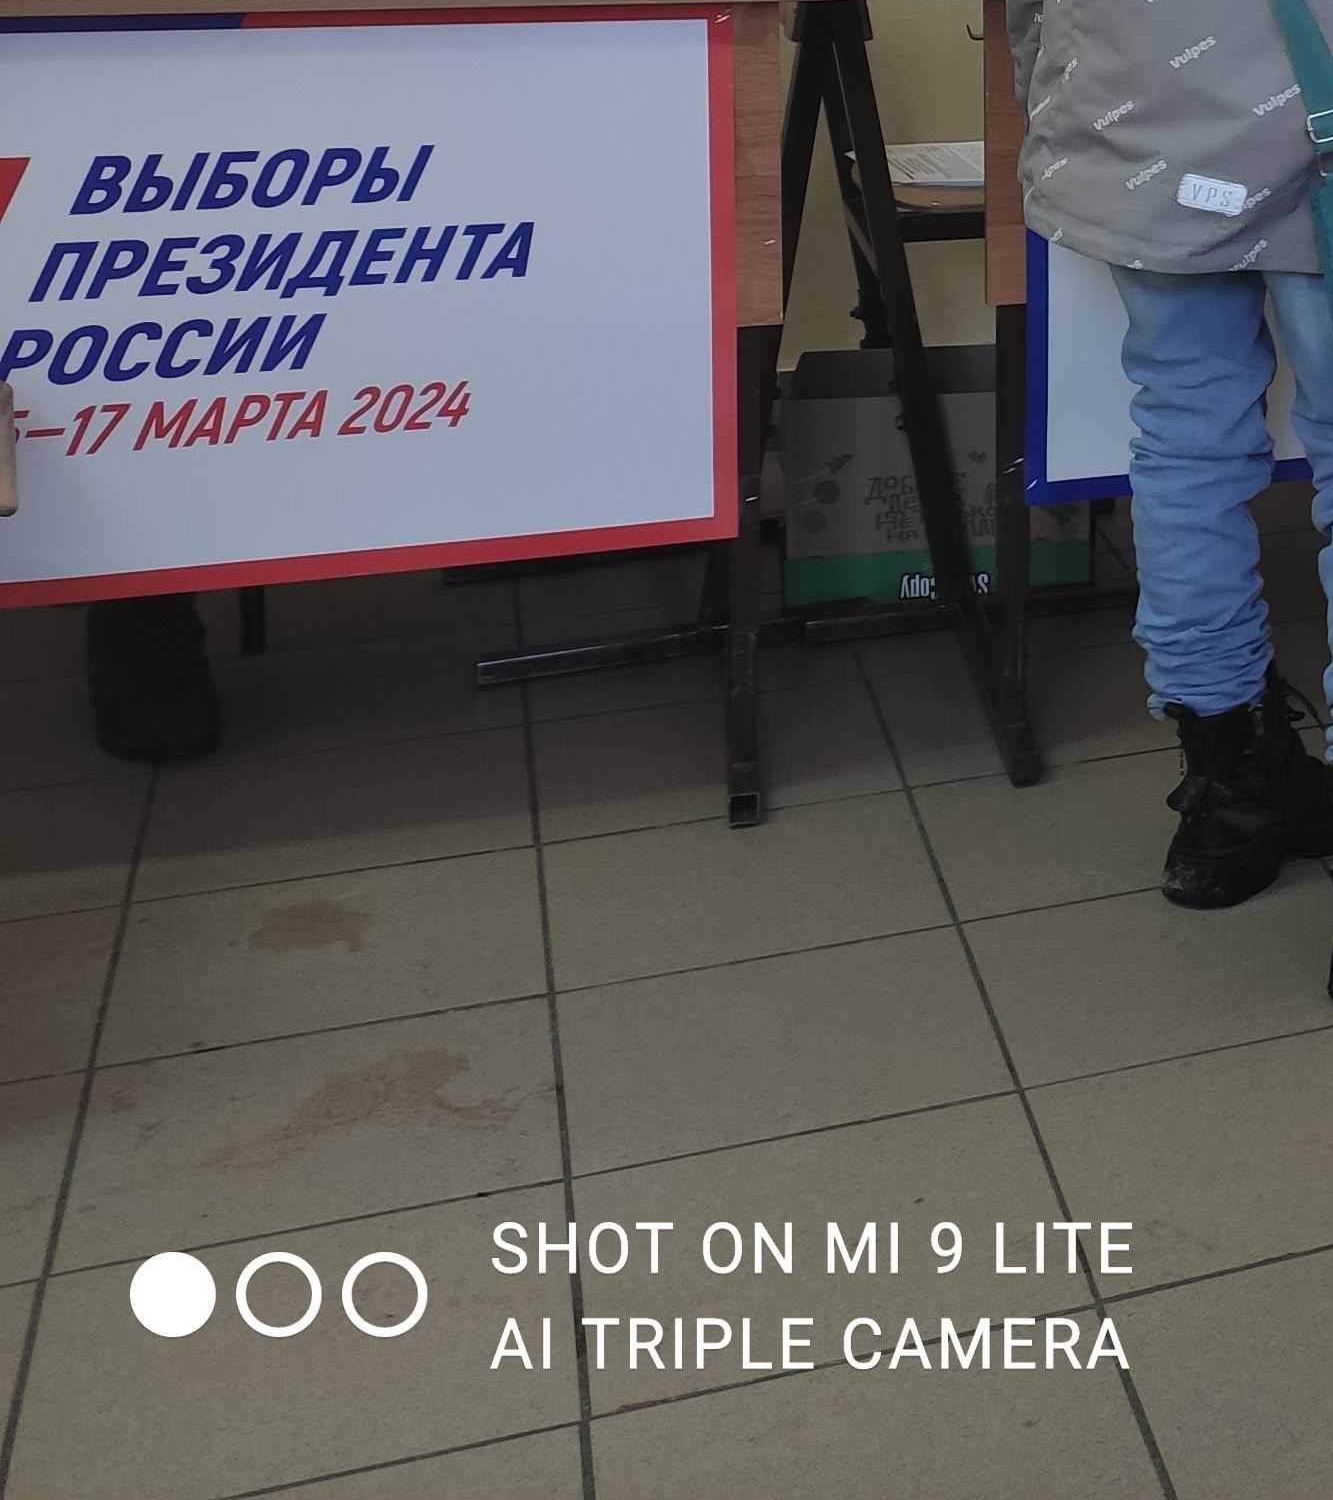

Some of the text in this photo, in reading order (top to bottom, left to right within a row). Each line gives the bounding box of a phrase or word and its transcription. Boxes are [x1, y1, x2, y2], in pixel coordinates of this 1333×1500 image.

[1168, 35, 1217, 70] Vulpes
[1093, 100, 1136, 131] Vulpes
[1250, 83, 1303, 117] Vulpes
[69, 144, 435, 216] ВЫБОРЫ
[1125, 158, 1169, 191] Vulpes
[1190, 182, 1235, 208] VPS
[28, 221, 535, 303] ПРЕЗИДЕНТА
[0, 313, 327, 386] РОССИИ
[132, 390, 329, 451] МАРТА
[337, 381, 470, 437] 2024
